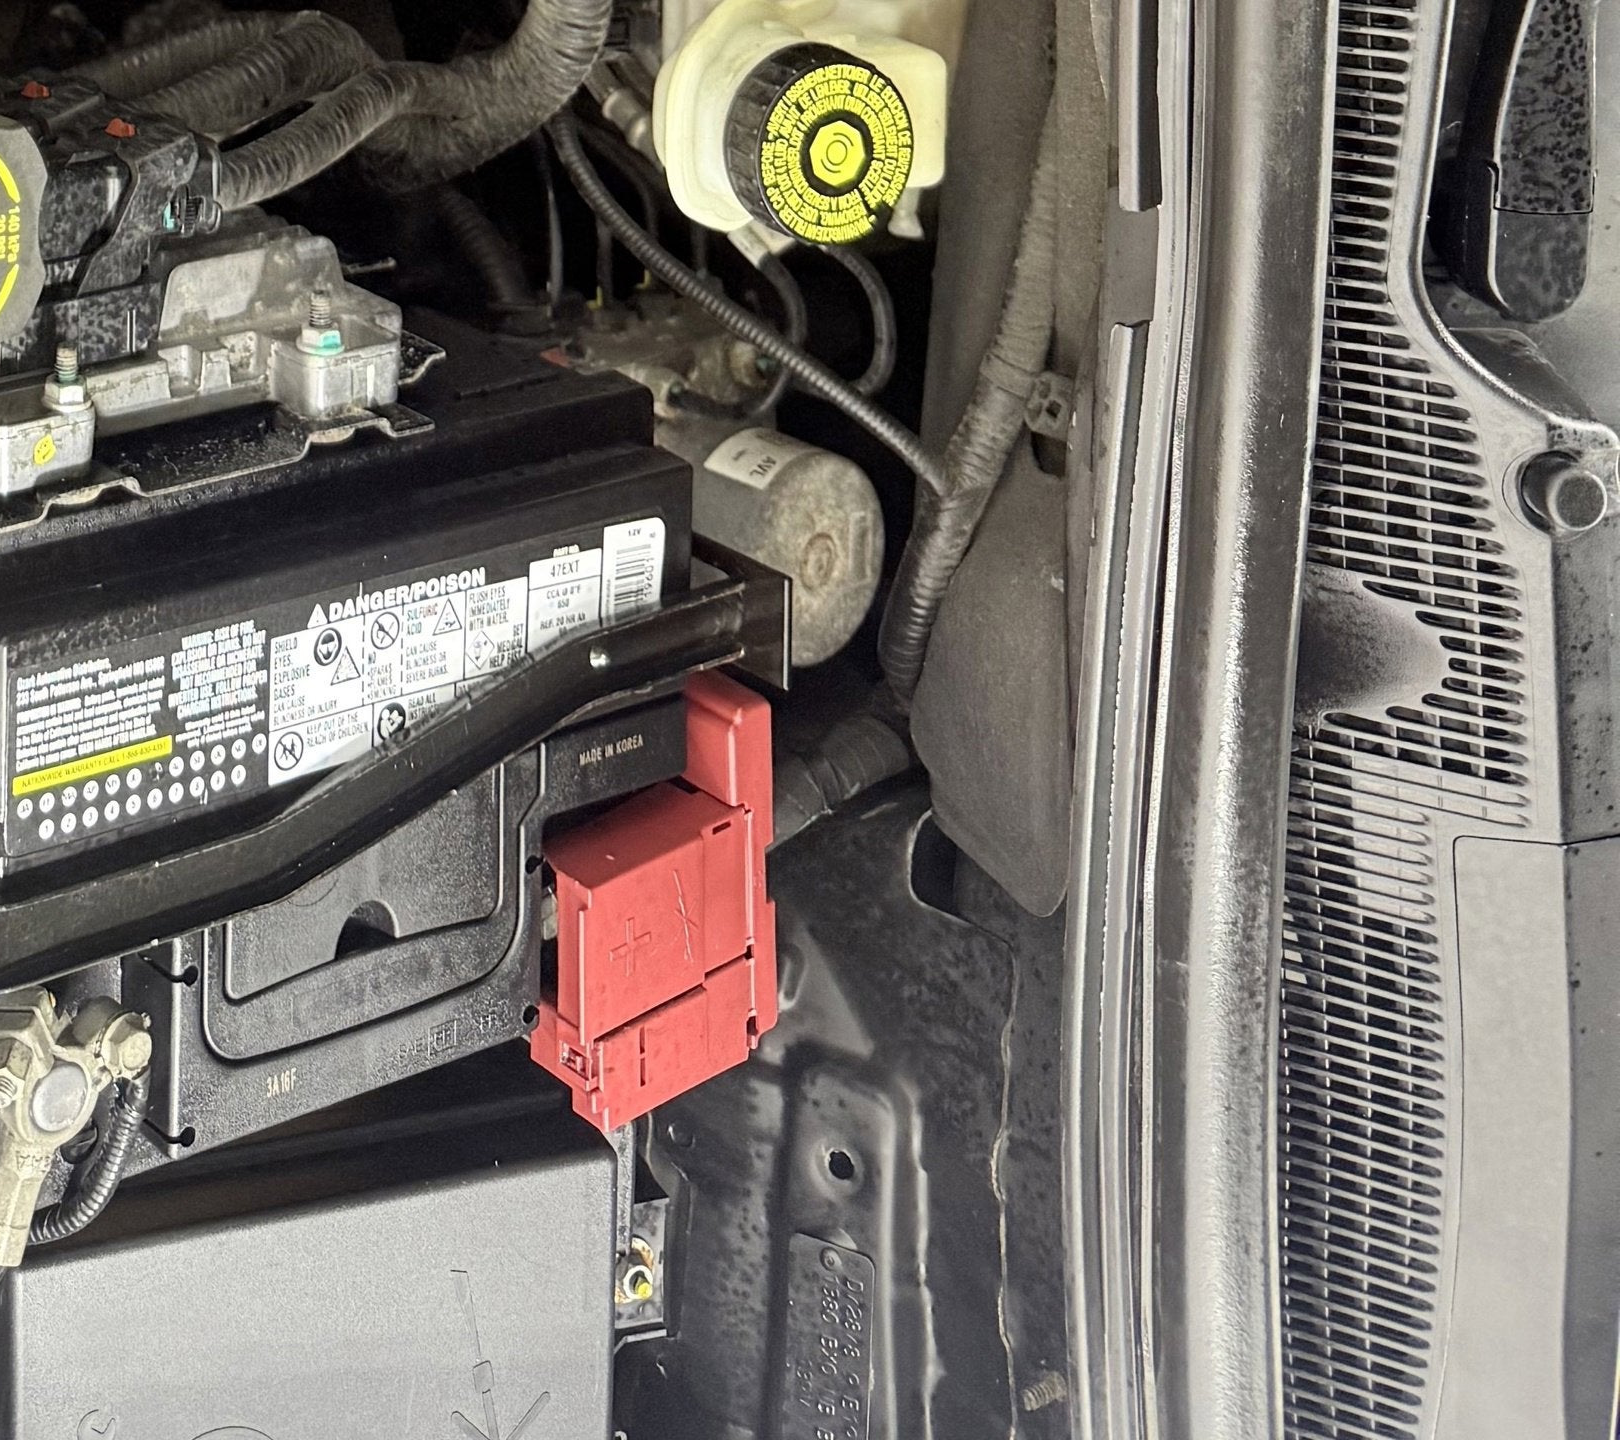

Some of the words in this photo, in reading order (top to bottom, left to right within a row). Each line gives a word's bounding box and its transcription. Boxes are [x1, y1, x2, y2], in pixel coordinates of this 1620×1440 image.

[7, 205, 21, 233] 140
[7, 235, 21, 263] kPa
[550, 559, 580, 578] 47EXT
[329, 566, 486, 622] DANGER/POISON
[490, 585, 506, 600] EYES
[406, 603, 438, 622] SULFURIC
[468, 597, 511, 618] IMMEDIATELY
[406, 621, 422, 636] ACID
[274, 636, 298, 655] SHIELD
[273, 664, 311, 686] EXPLOSIVE
[273, 684, 295, 701] GASES
[579, 747, 602, 766] MADE
[605, 743, 613, 758] IN
[616, 733, 643, 754] KOREA
[22, 771, 63, 788] NATIONWIDE
[65, 759, 103, 777] WARRANTY
[103, 754, 120, 767] CALL
